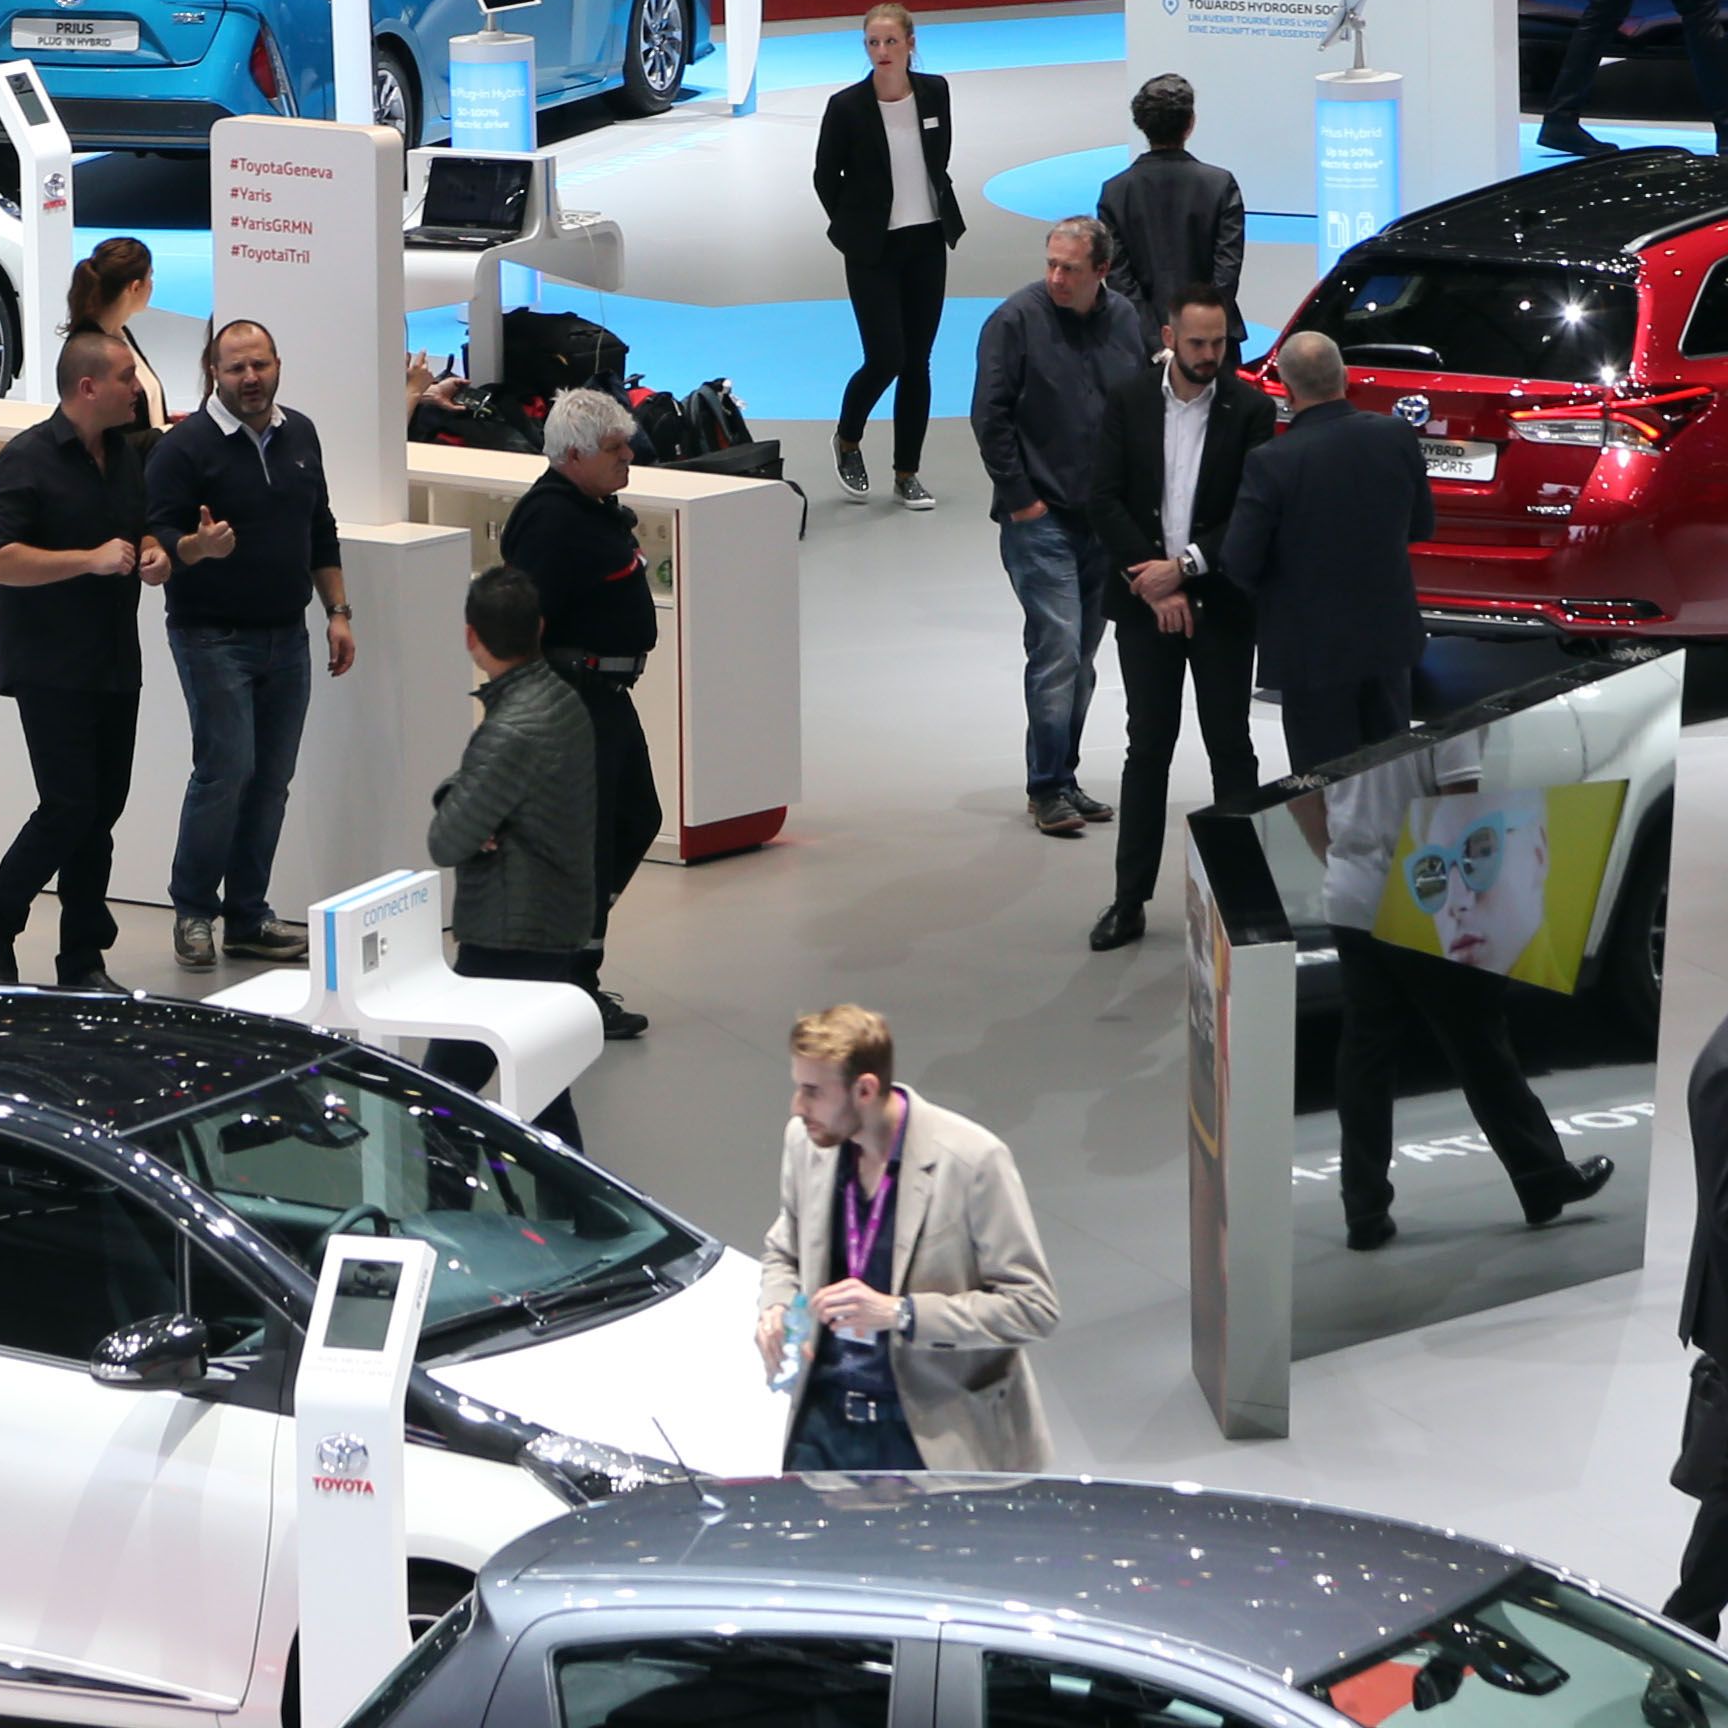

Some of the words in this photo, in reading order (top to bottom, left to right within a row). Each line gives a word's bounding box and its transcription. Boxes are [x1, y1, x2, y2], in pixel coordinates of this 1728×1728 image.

[1188, 0, 1246, 11] TOWARDS
[1247, 1, 1313, 15] HYDROGEN
[1188, 14, 1202, 22] UN
[1203, 15, 1234, 24] AVENIR
[1237, 15, 1271, 25] TOURNÉ
[1272, 18, 1295, 26] VERS
[56, 22, 94, 34] PRIUS
[1188, 25, 1209, 33] EINE
[1210, 26, 1250, 36] ZUKUNFT
[37, 36, 62, 46] PLUG
[66, 37, 75, 46] IN
[77, 37, 112, 47] HYBRID
[491, 87, 526, 102] Hybrid
[1343, 127, 1383, 140] Hybrid
[1326, 148, 1336, 158] Up
[1338, 149, 1348, 157] to
[1349, 148, 1375, 158] 50%
[230, 157, 333, 181] #ToyotaGeneva
[230, 186, 272, 204] #Yaris
[230, 215, 313, 235] #YarisGRMN
[1420, 444, 1465, 458] HYBRID
[1425, 459, 1473, 475] SPORTS
[363, 893, 409, 927] connect
[410, 887, 429, 908] me
[312, 1476, 375, 1494] TOYOTA
